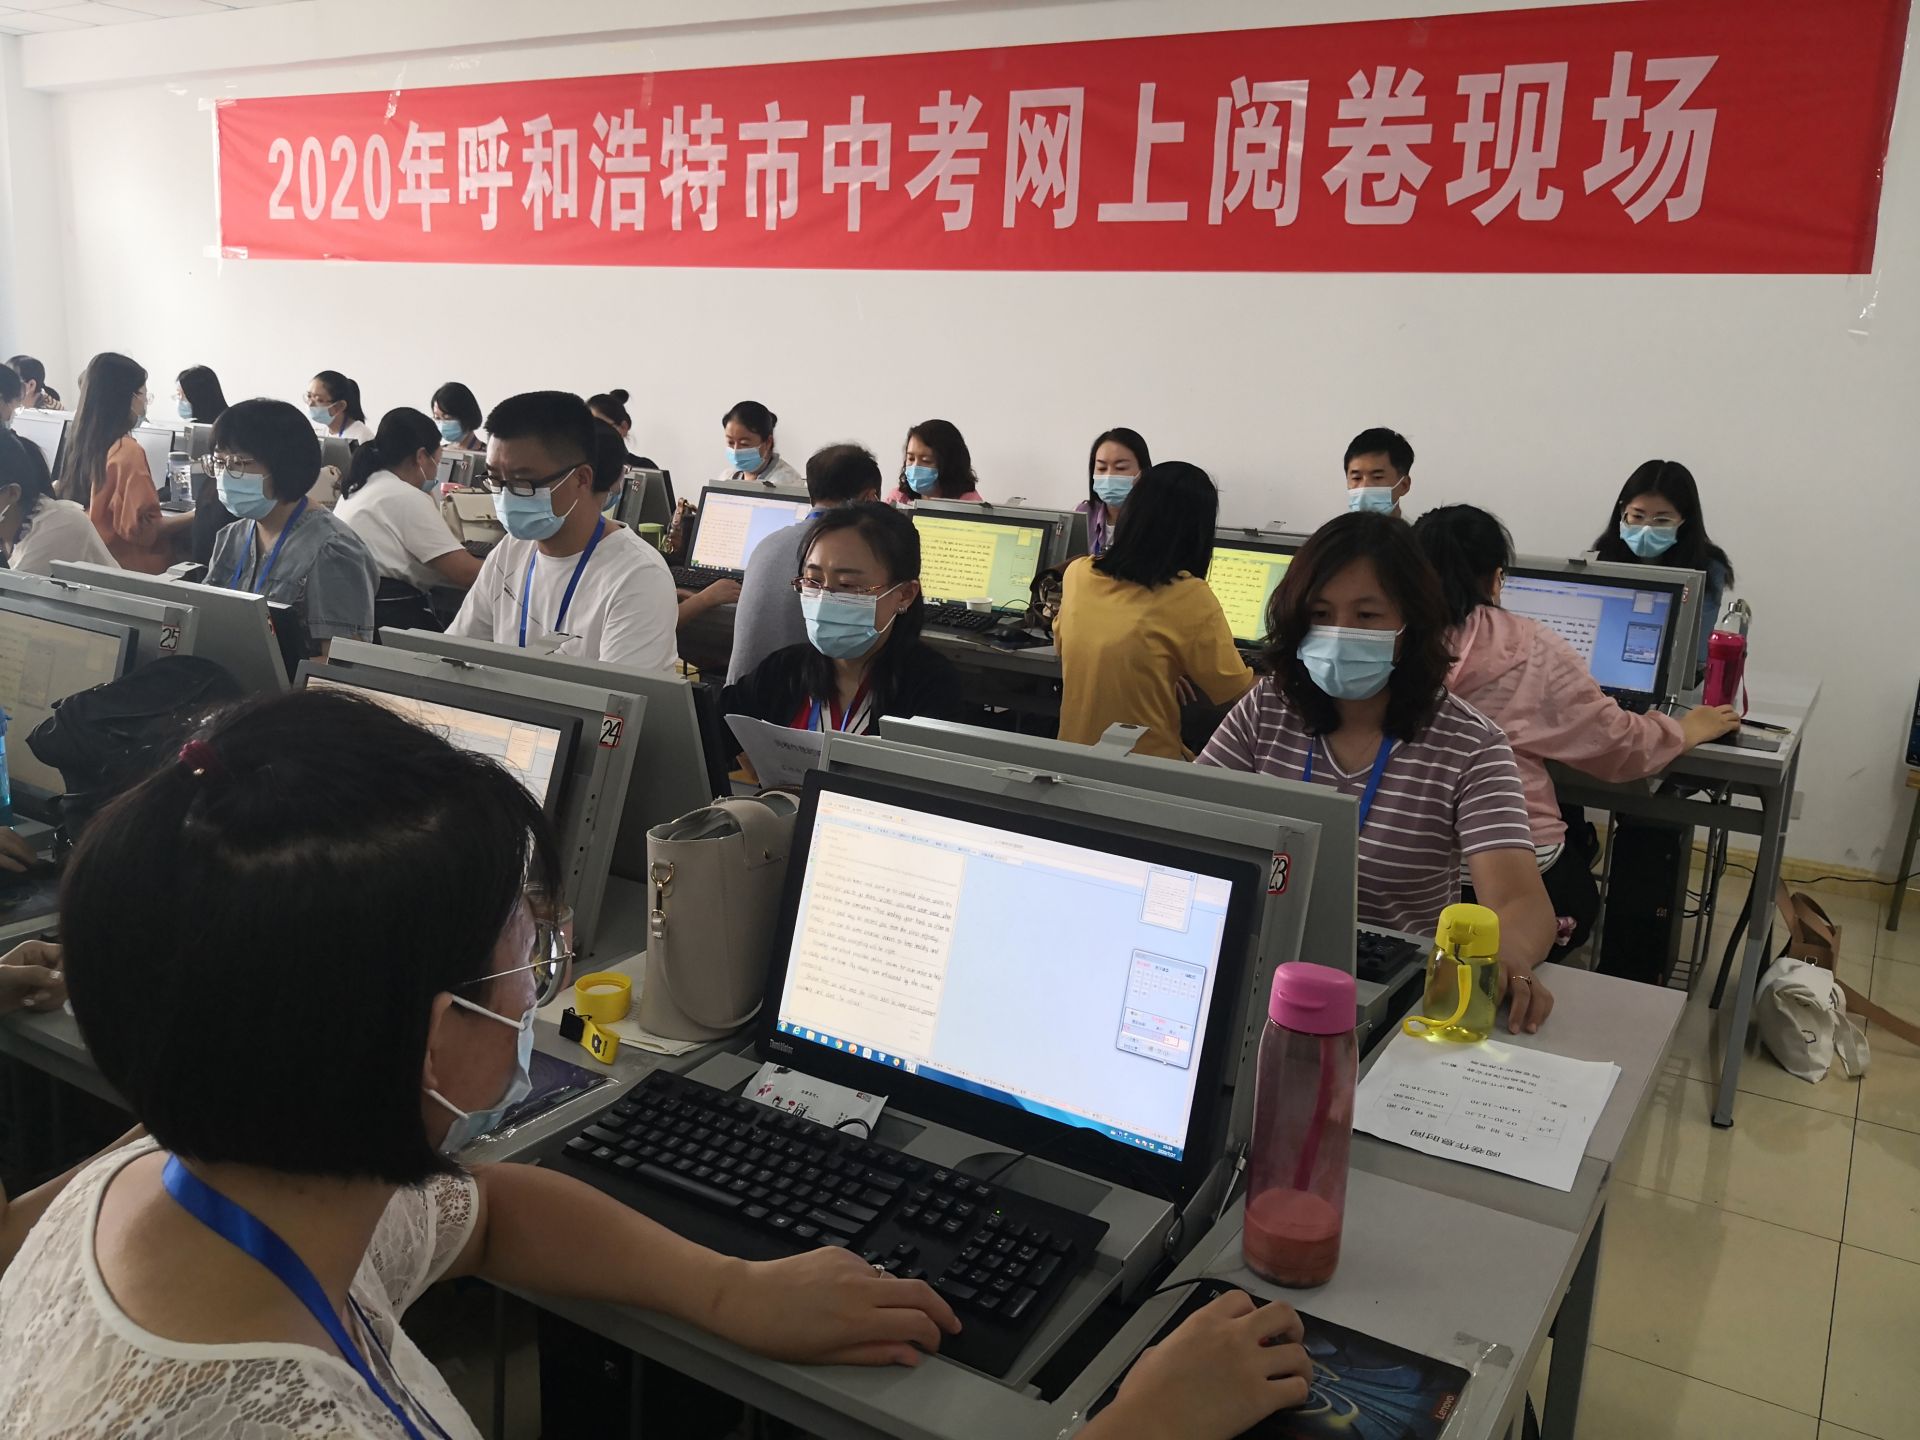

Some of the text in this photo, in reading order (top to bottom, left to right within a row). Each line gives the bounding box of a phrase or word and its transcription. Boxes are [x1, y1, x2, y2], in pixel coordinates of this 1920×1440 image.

[268, 51, 1720, 232] 2020年呼和浩特市中考网上阅卷现场
[160, 627, 180, 649] 25
[599, 719, 621, 747] 24
[1269, 856, 1287, 891] 23
